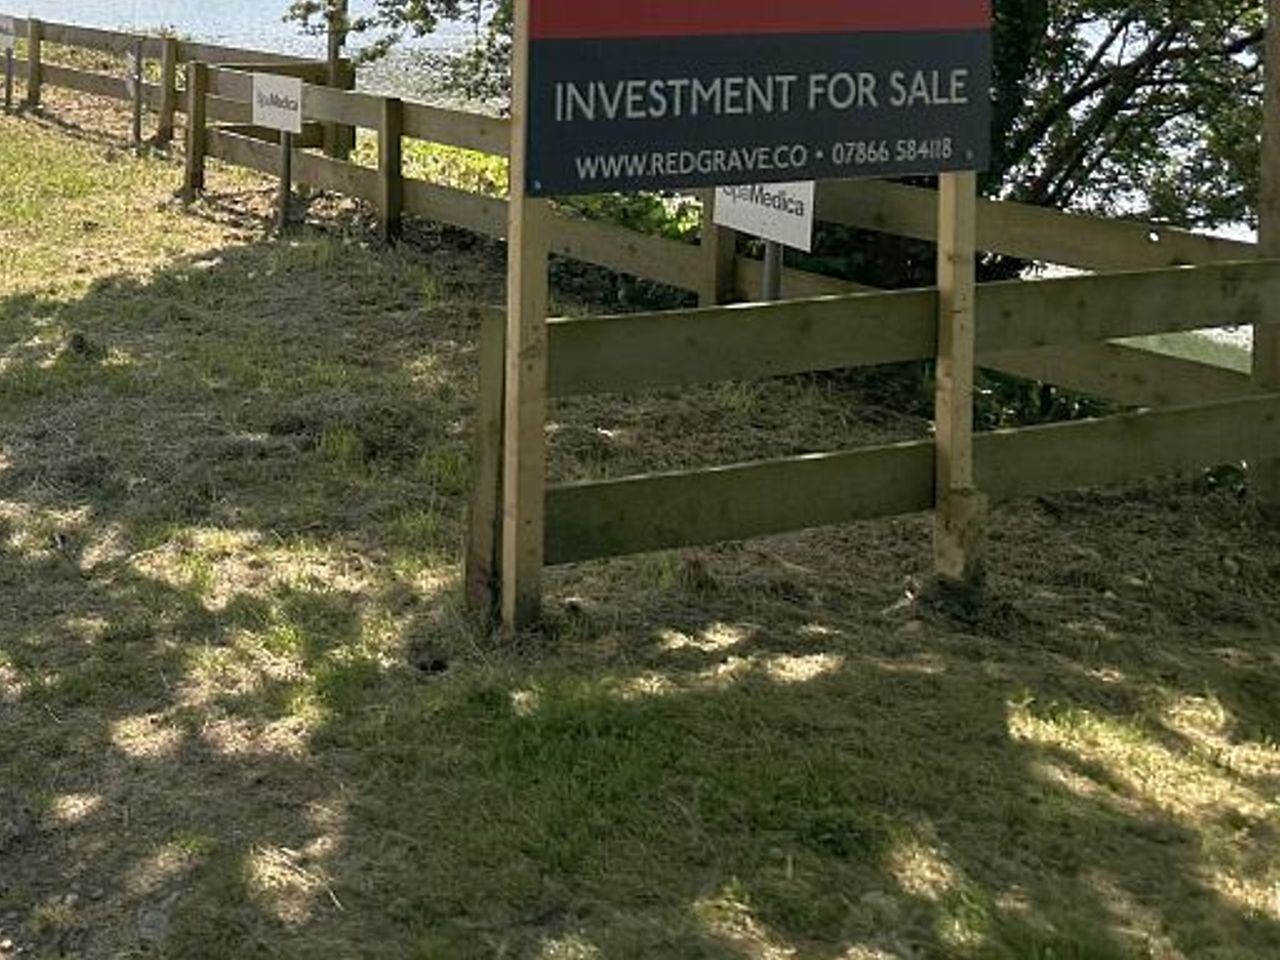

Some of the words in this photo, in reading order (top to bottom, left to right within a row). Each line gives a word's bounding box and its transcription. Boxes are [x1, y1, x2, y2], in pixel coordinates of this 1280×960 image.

[554, 74, 798, 121] INVESTMENT
[807, 72, 879, 111] FOR
[889, 69, 969, 107] SALE
[831, 142, 890, 165] 07866
